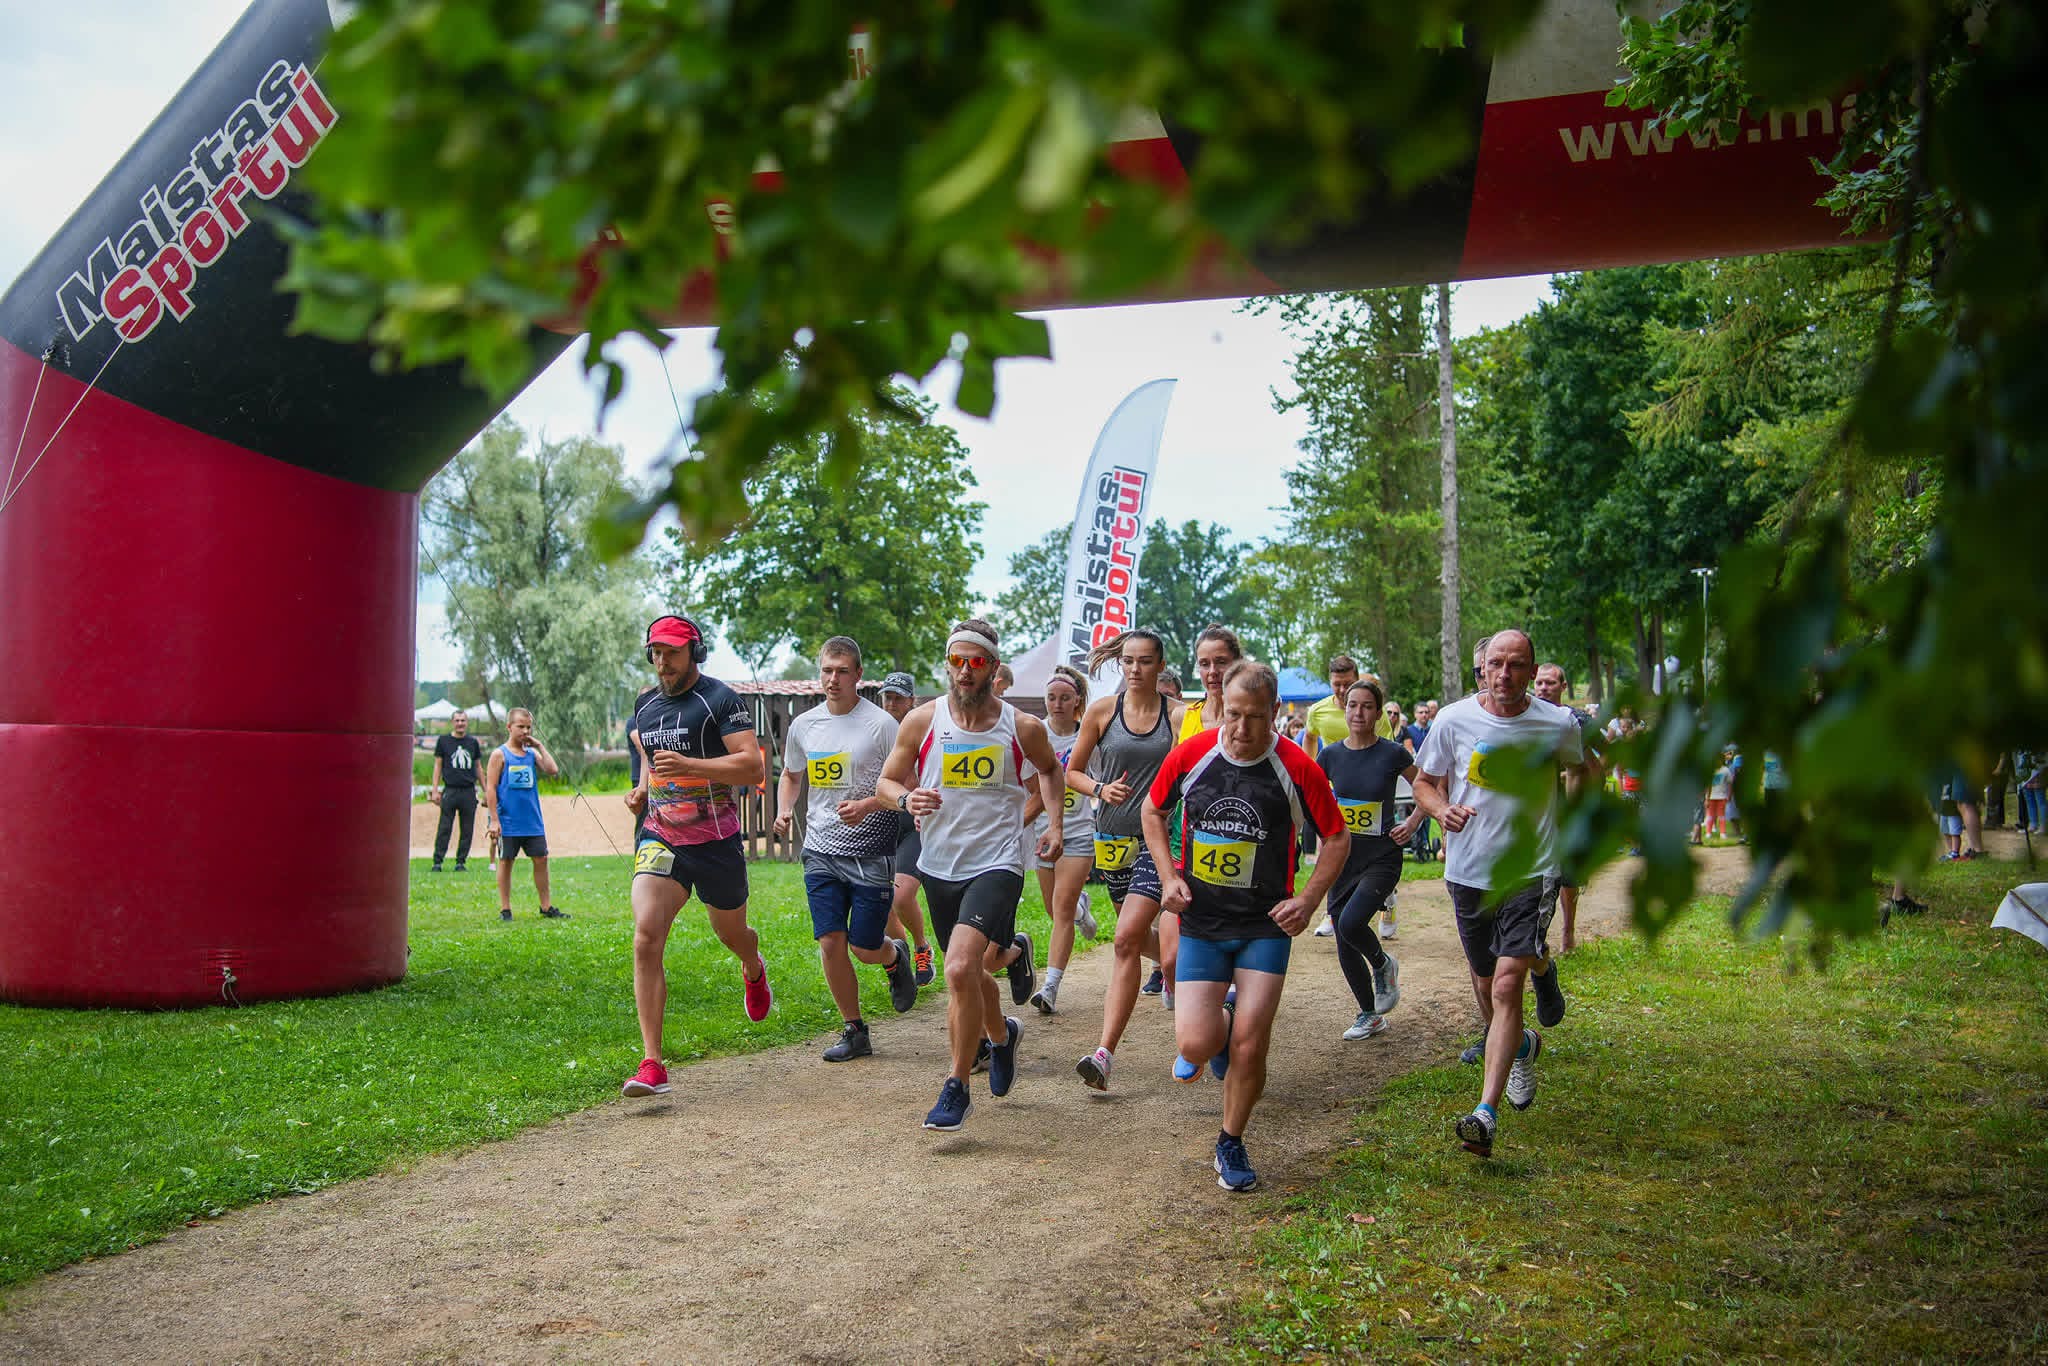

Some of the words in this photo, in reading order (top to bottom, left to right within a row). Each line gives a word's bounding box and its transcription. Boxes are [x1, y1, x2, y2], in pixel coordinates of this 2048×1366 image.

[1558, 94, 1857, 163] www.ma
[56, 59, 296, 342] Maistas
[101, 63, 340, 343] Sportui
[1068, 471, 1120, 674] Maistas
[514, 771, 531, 784] 23
[814, 761, 843, 781] 59
[950, 756, 995, 780] 40
[1344, 807, 1373, 828] 38
[636, 846, 667, 866] 57
[1104, 843, 1130, 864] 37
[1199, 848, 1242, 878] 48
